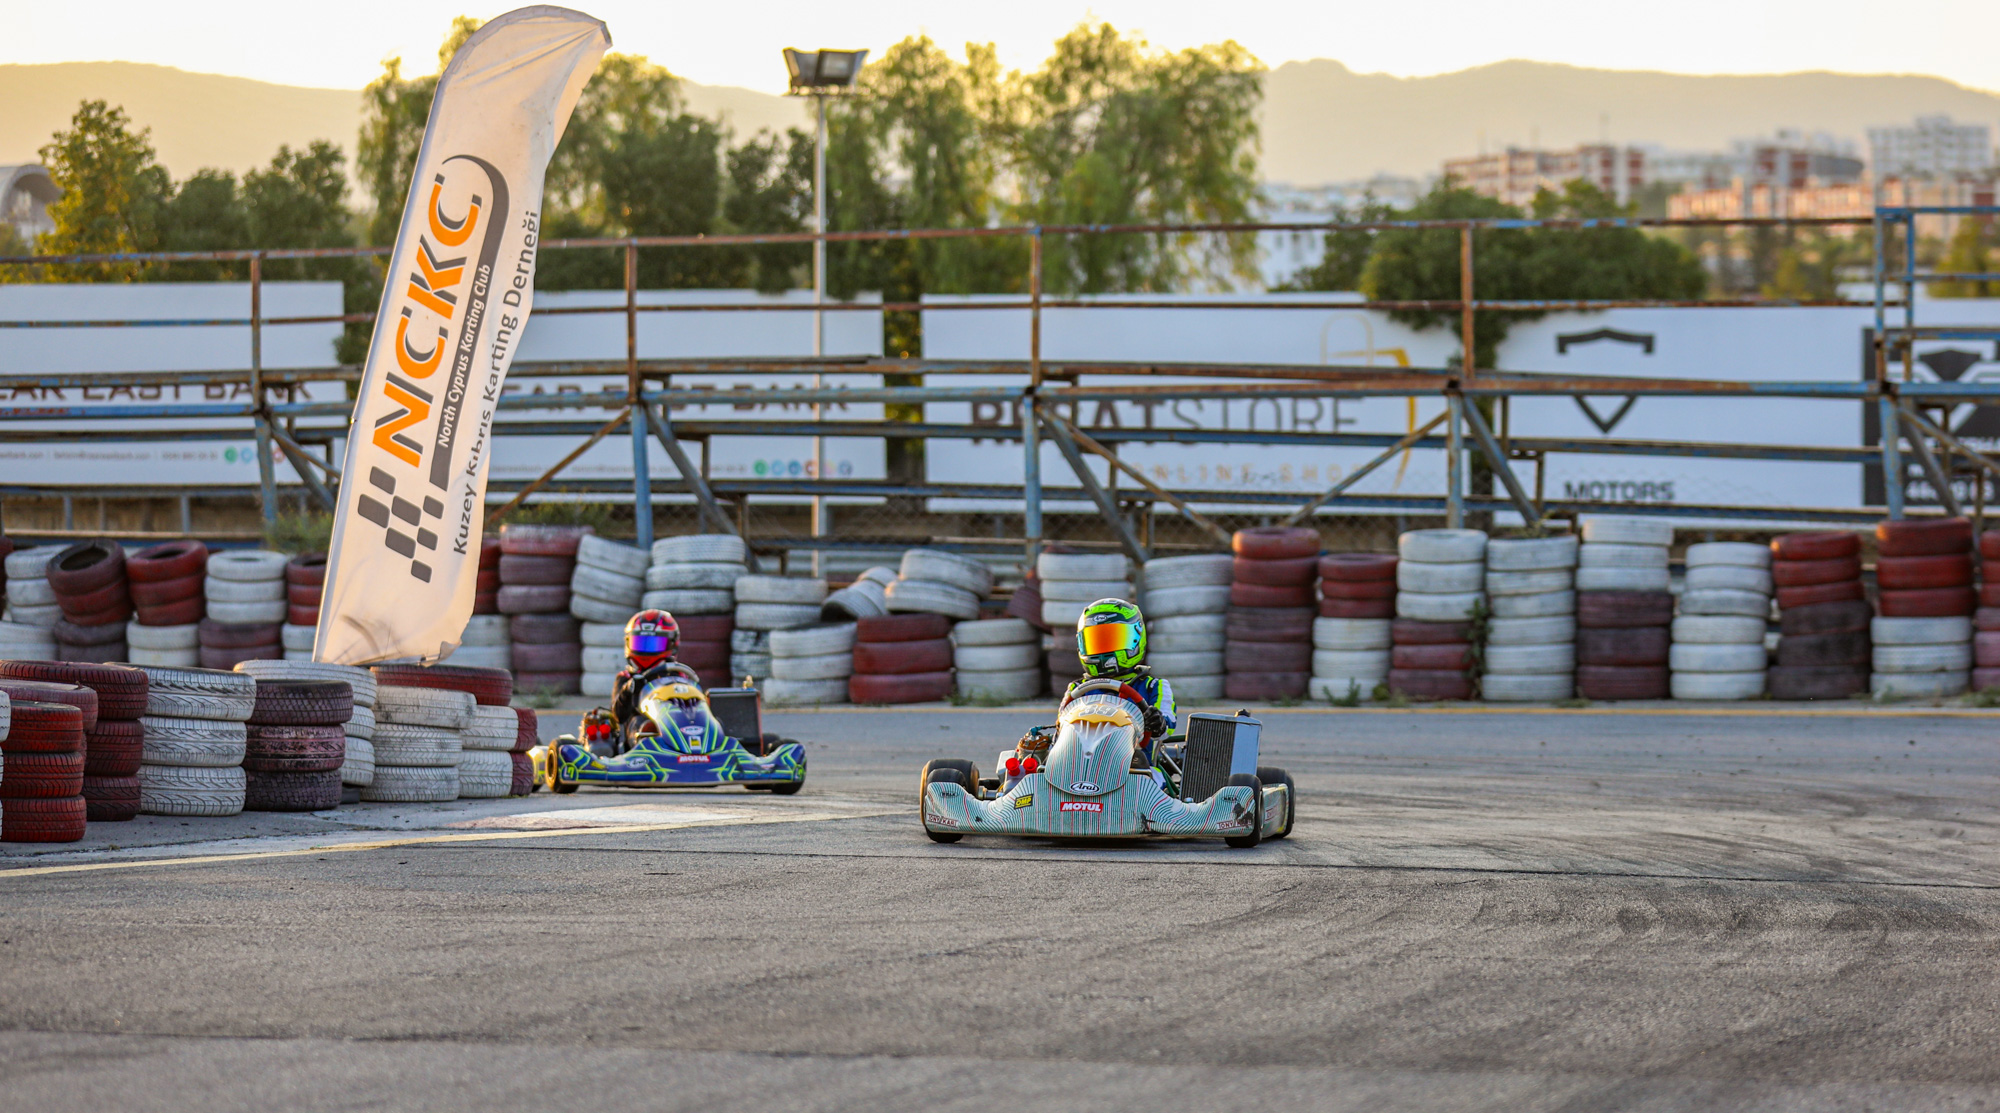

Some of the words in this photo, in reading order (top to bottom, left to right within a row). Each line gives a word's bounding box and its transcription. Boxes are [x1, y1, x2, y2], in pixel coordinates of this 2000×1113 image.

[372, 173, 482, 468] NCKC
[438, 405, 457, 448] North
[449, 354, 469, 402] Cyprus
[460, 298, 485, 352] Karting
[474, 264, 491, 296] Club
[453, 483, 477, 555] Kuzey
[483, 313, 518, 402] Karting
[503, 210, 538, 308] Derneği
[1563, 480, 1675, 503] MOTORS
[1074, 782, 1097, 792] Arai
[1016, 796, 1032, 806] OMP
[1062, 803, 1101, 812] MOTUL
